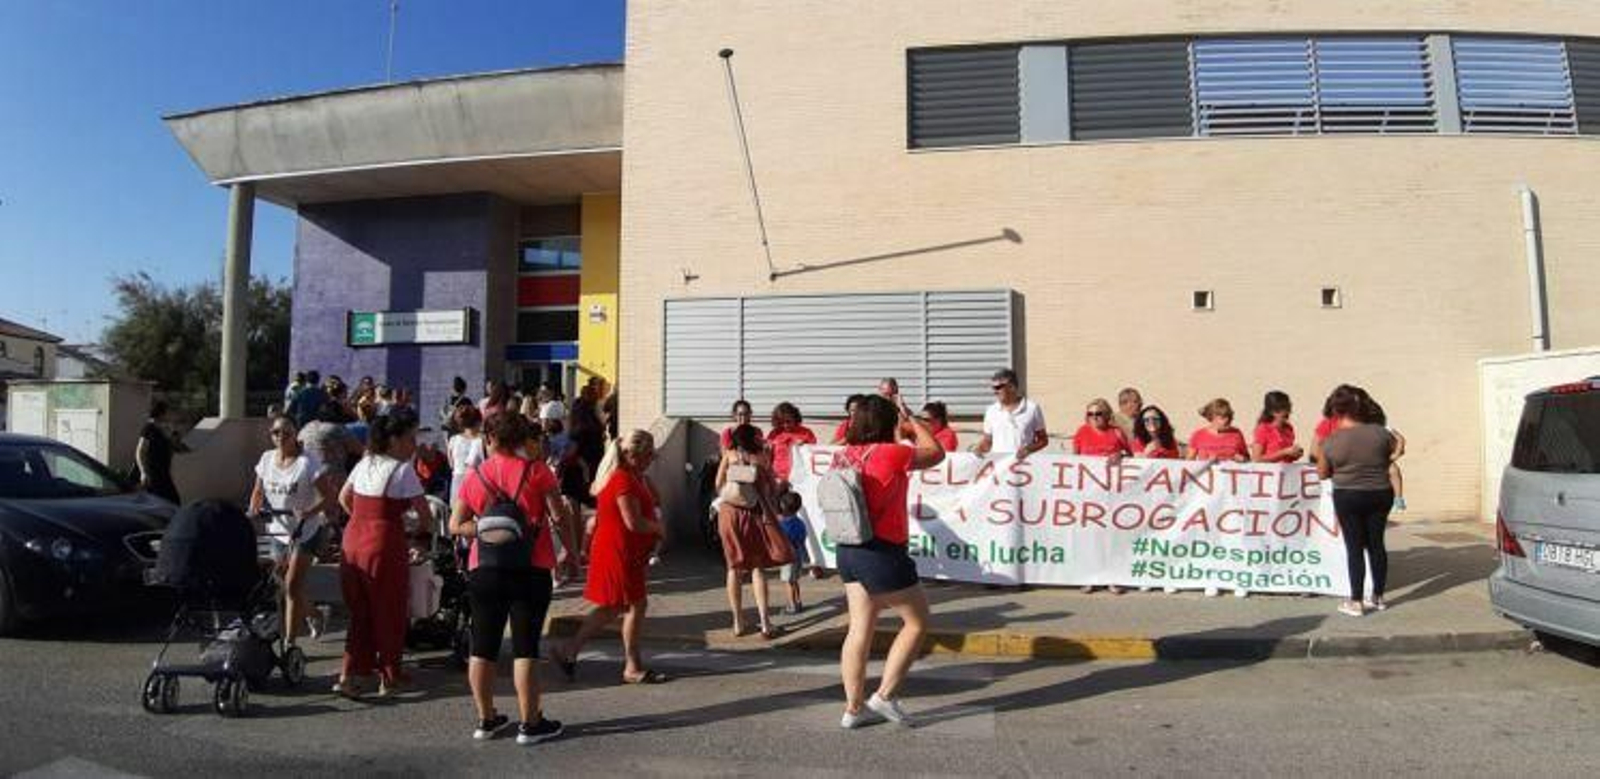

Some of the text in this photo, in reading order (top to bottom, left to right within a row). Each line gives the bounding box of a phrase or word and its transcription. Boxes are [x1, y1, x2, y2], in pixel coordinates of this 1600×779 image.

[810, 450, 1322, 501] EELAS INFANTILE
[987, 498, 1340, 539] SUBROGACIÓN
[947, 541, 979, 562] en
[990, 539, 1065, 564] lucha
[1132, 537, 1322, 565] #NoDespidos
[1131, 561, 1332, 589] #Subrogación
